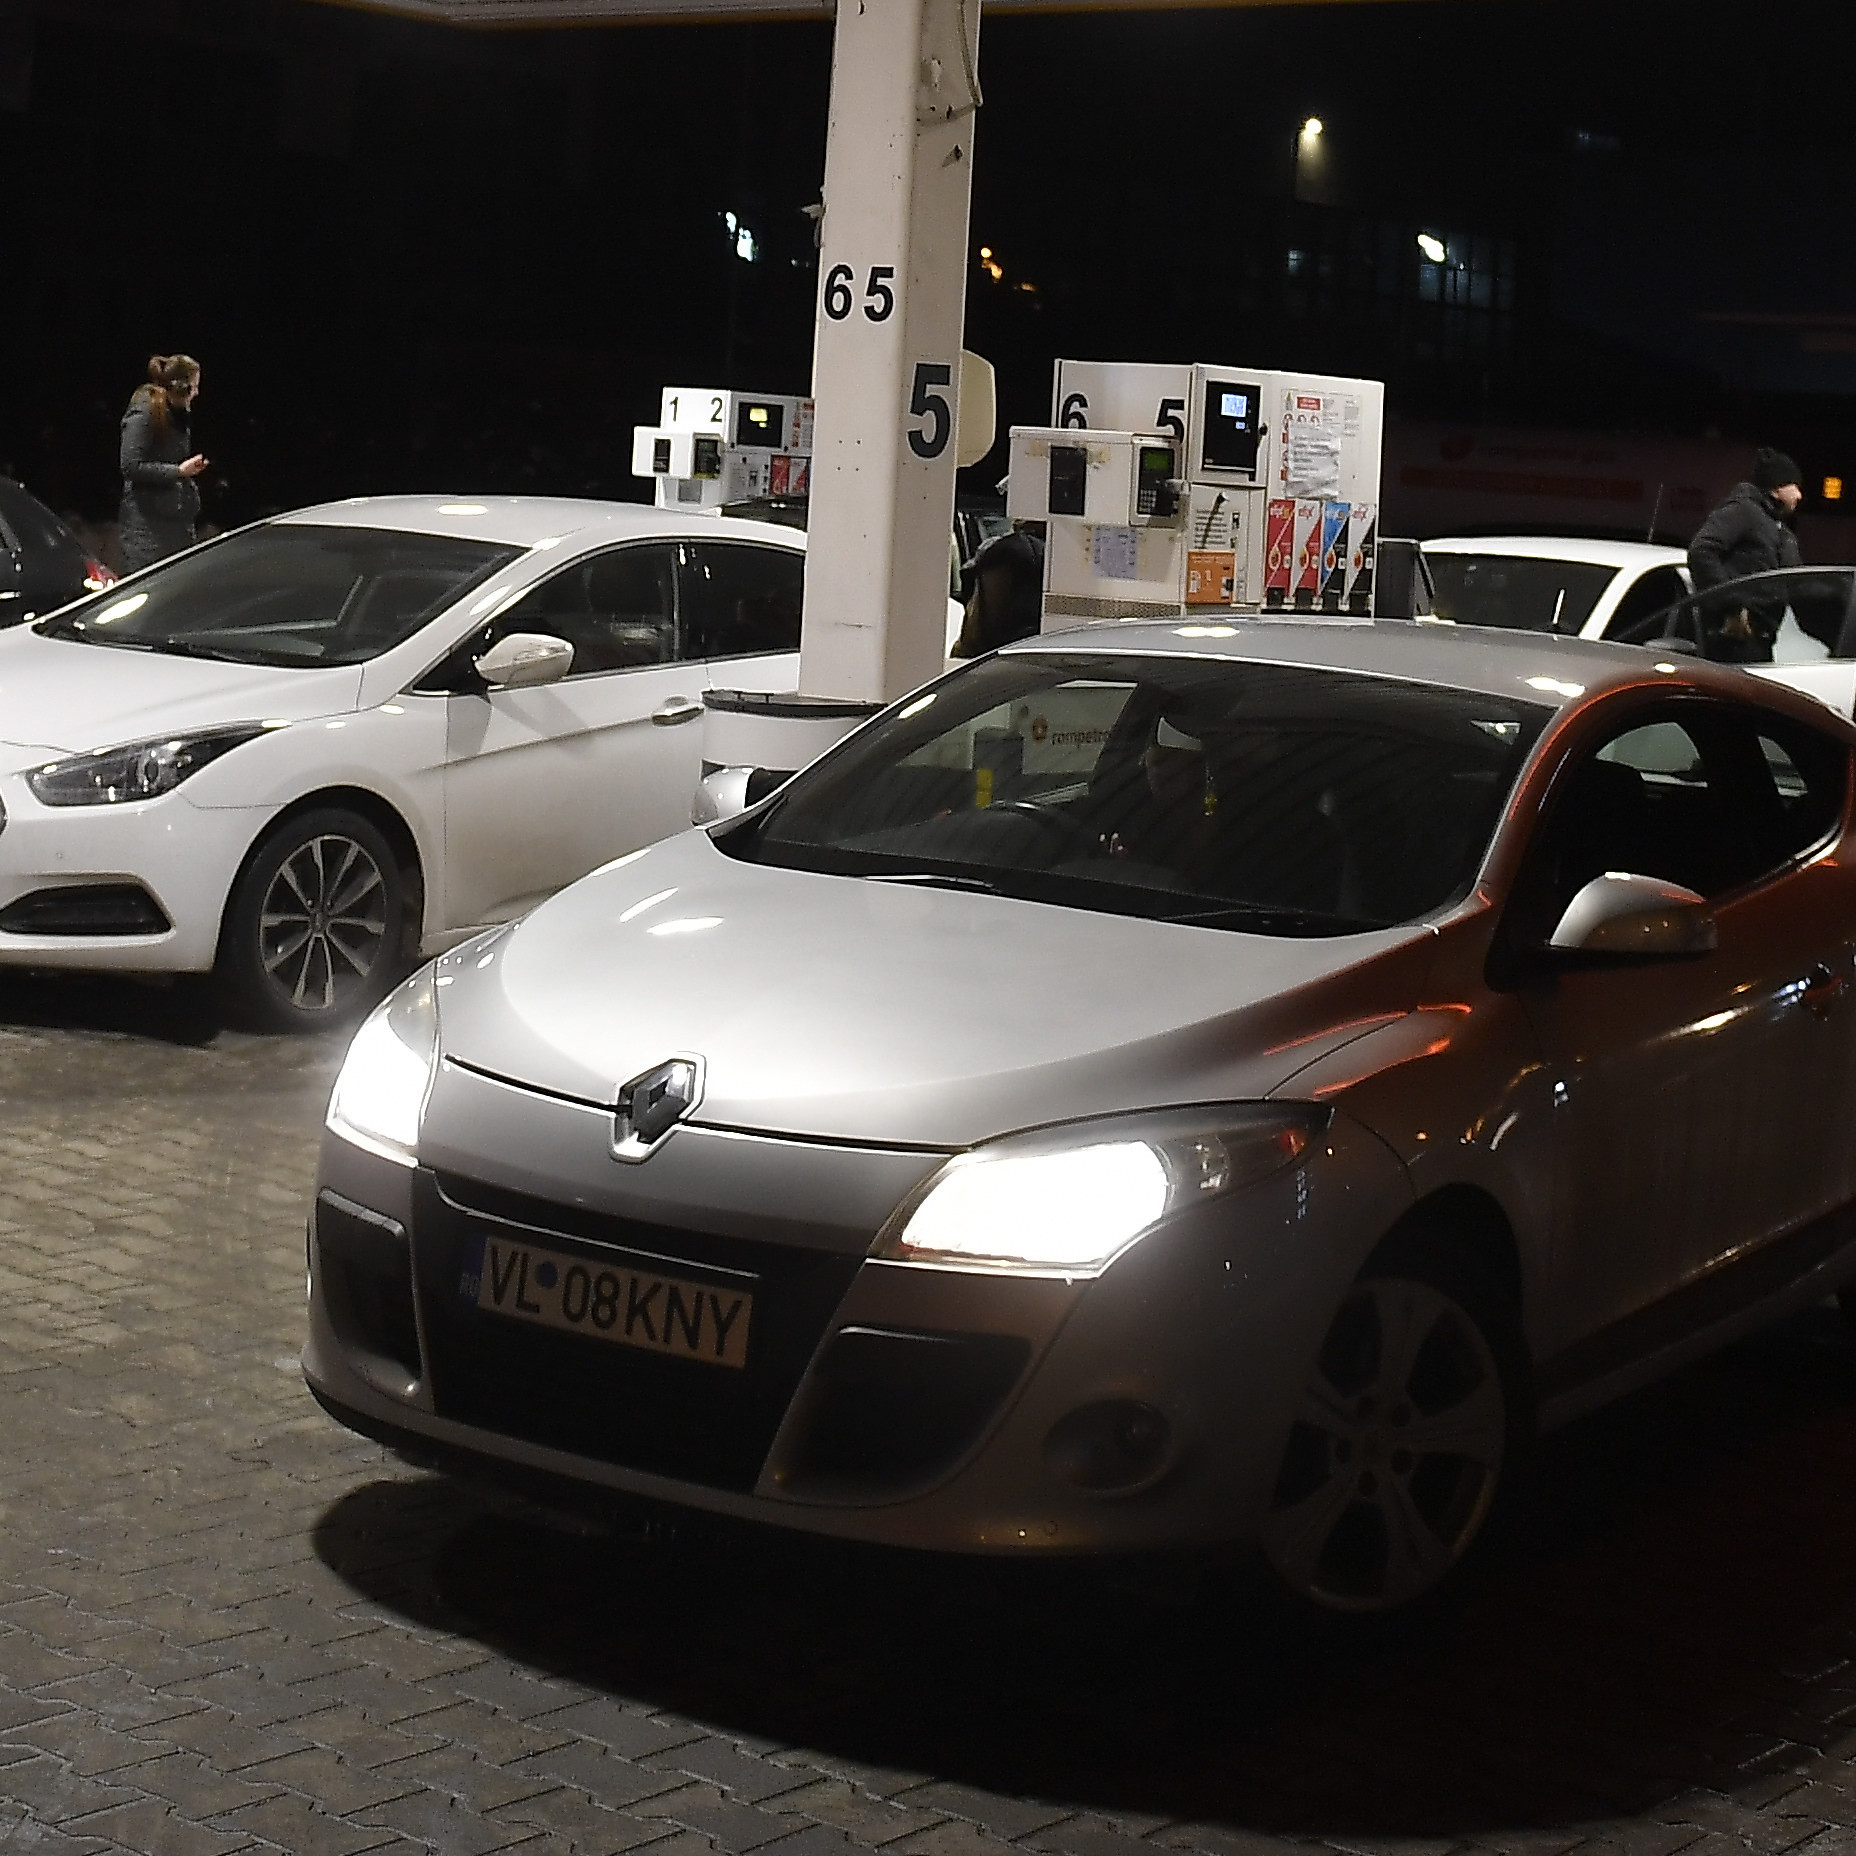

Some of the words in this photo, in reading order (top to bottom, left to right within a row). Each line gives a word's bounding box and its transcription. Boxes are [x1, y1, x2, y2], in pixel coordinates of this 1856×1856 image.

[824, 264, 895, 323] 65
[669, 396, 679, 422] 1
[710, 396, 723, 423] 2
[907, 362, 952, 459] 5
[1061, 393, 1089, 429] 6
[1156, 398, 1185, 445] 5
[490, 1246, 540, 1314] VL
[562, 1264, 743, 1357] 08KNY
